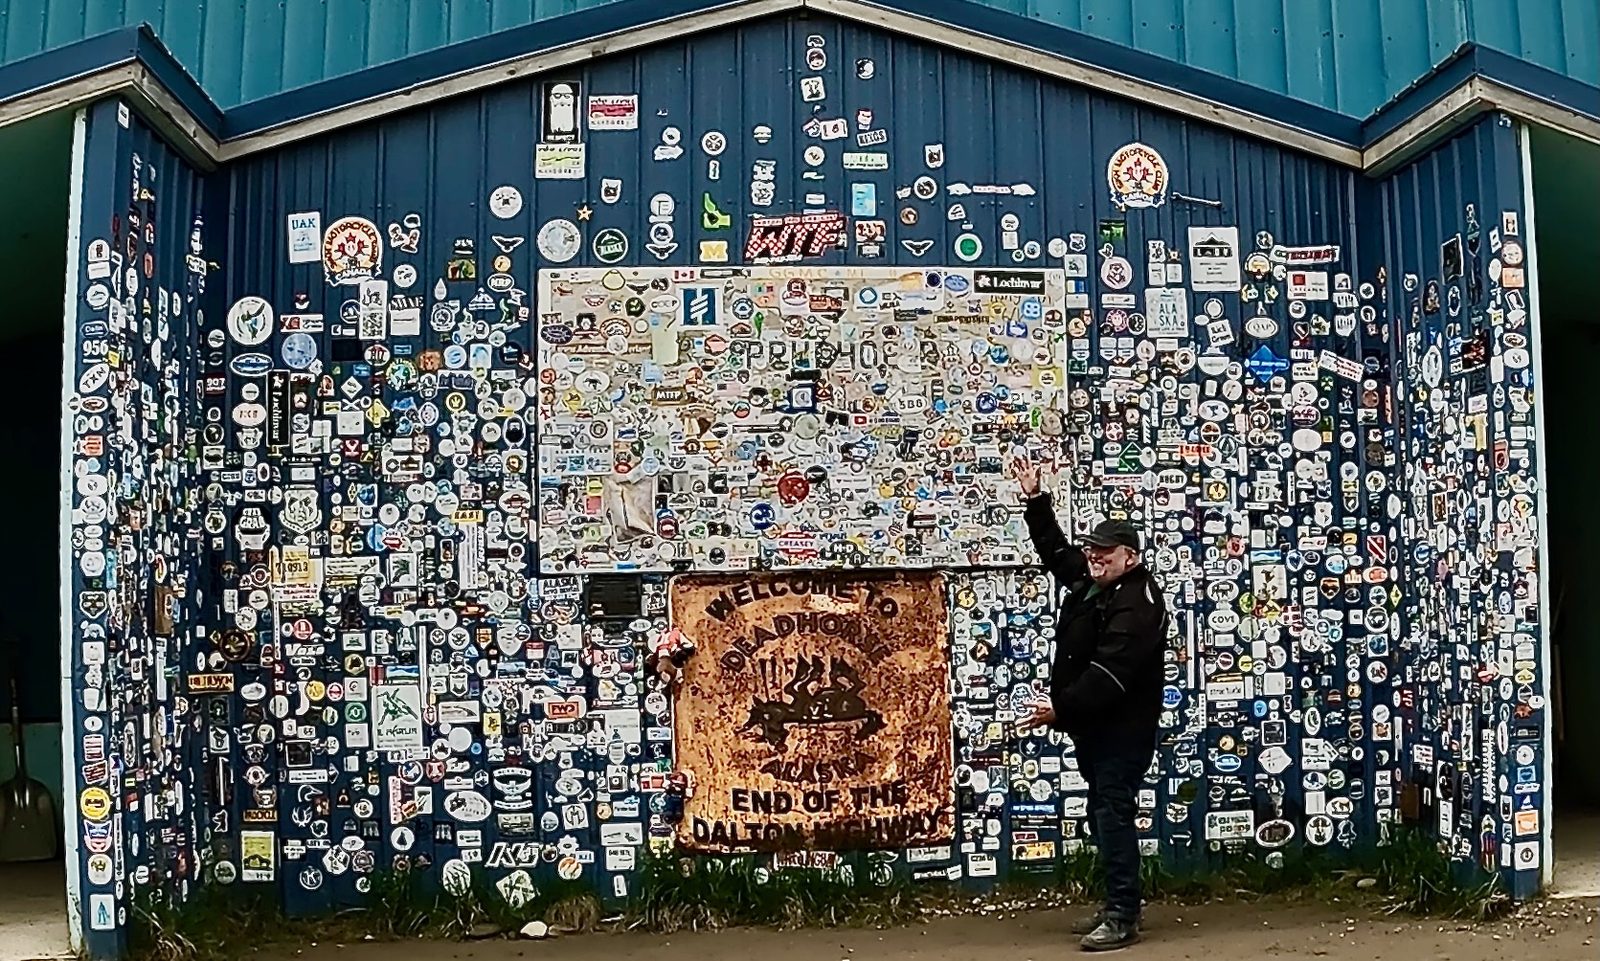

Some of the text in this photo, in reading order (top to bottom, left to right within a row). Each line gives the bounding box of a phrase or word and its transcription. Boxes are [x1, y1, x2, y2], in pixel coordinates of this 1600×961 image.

[83, 340, 108, 356] 956
[731, 779, 906, 815] END OF THE
[692, 815, 802, 846] DALTON
